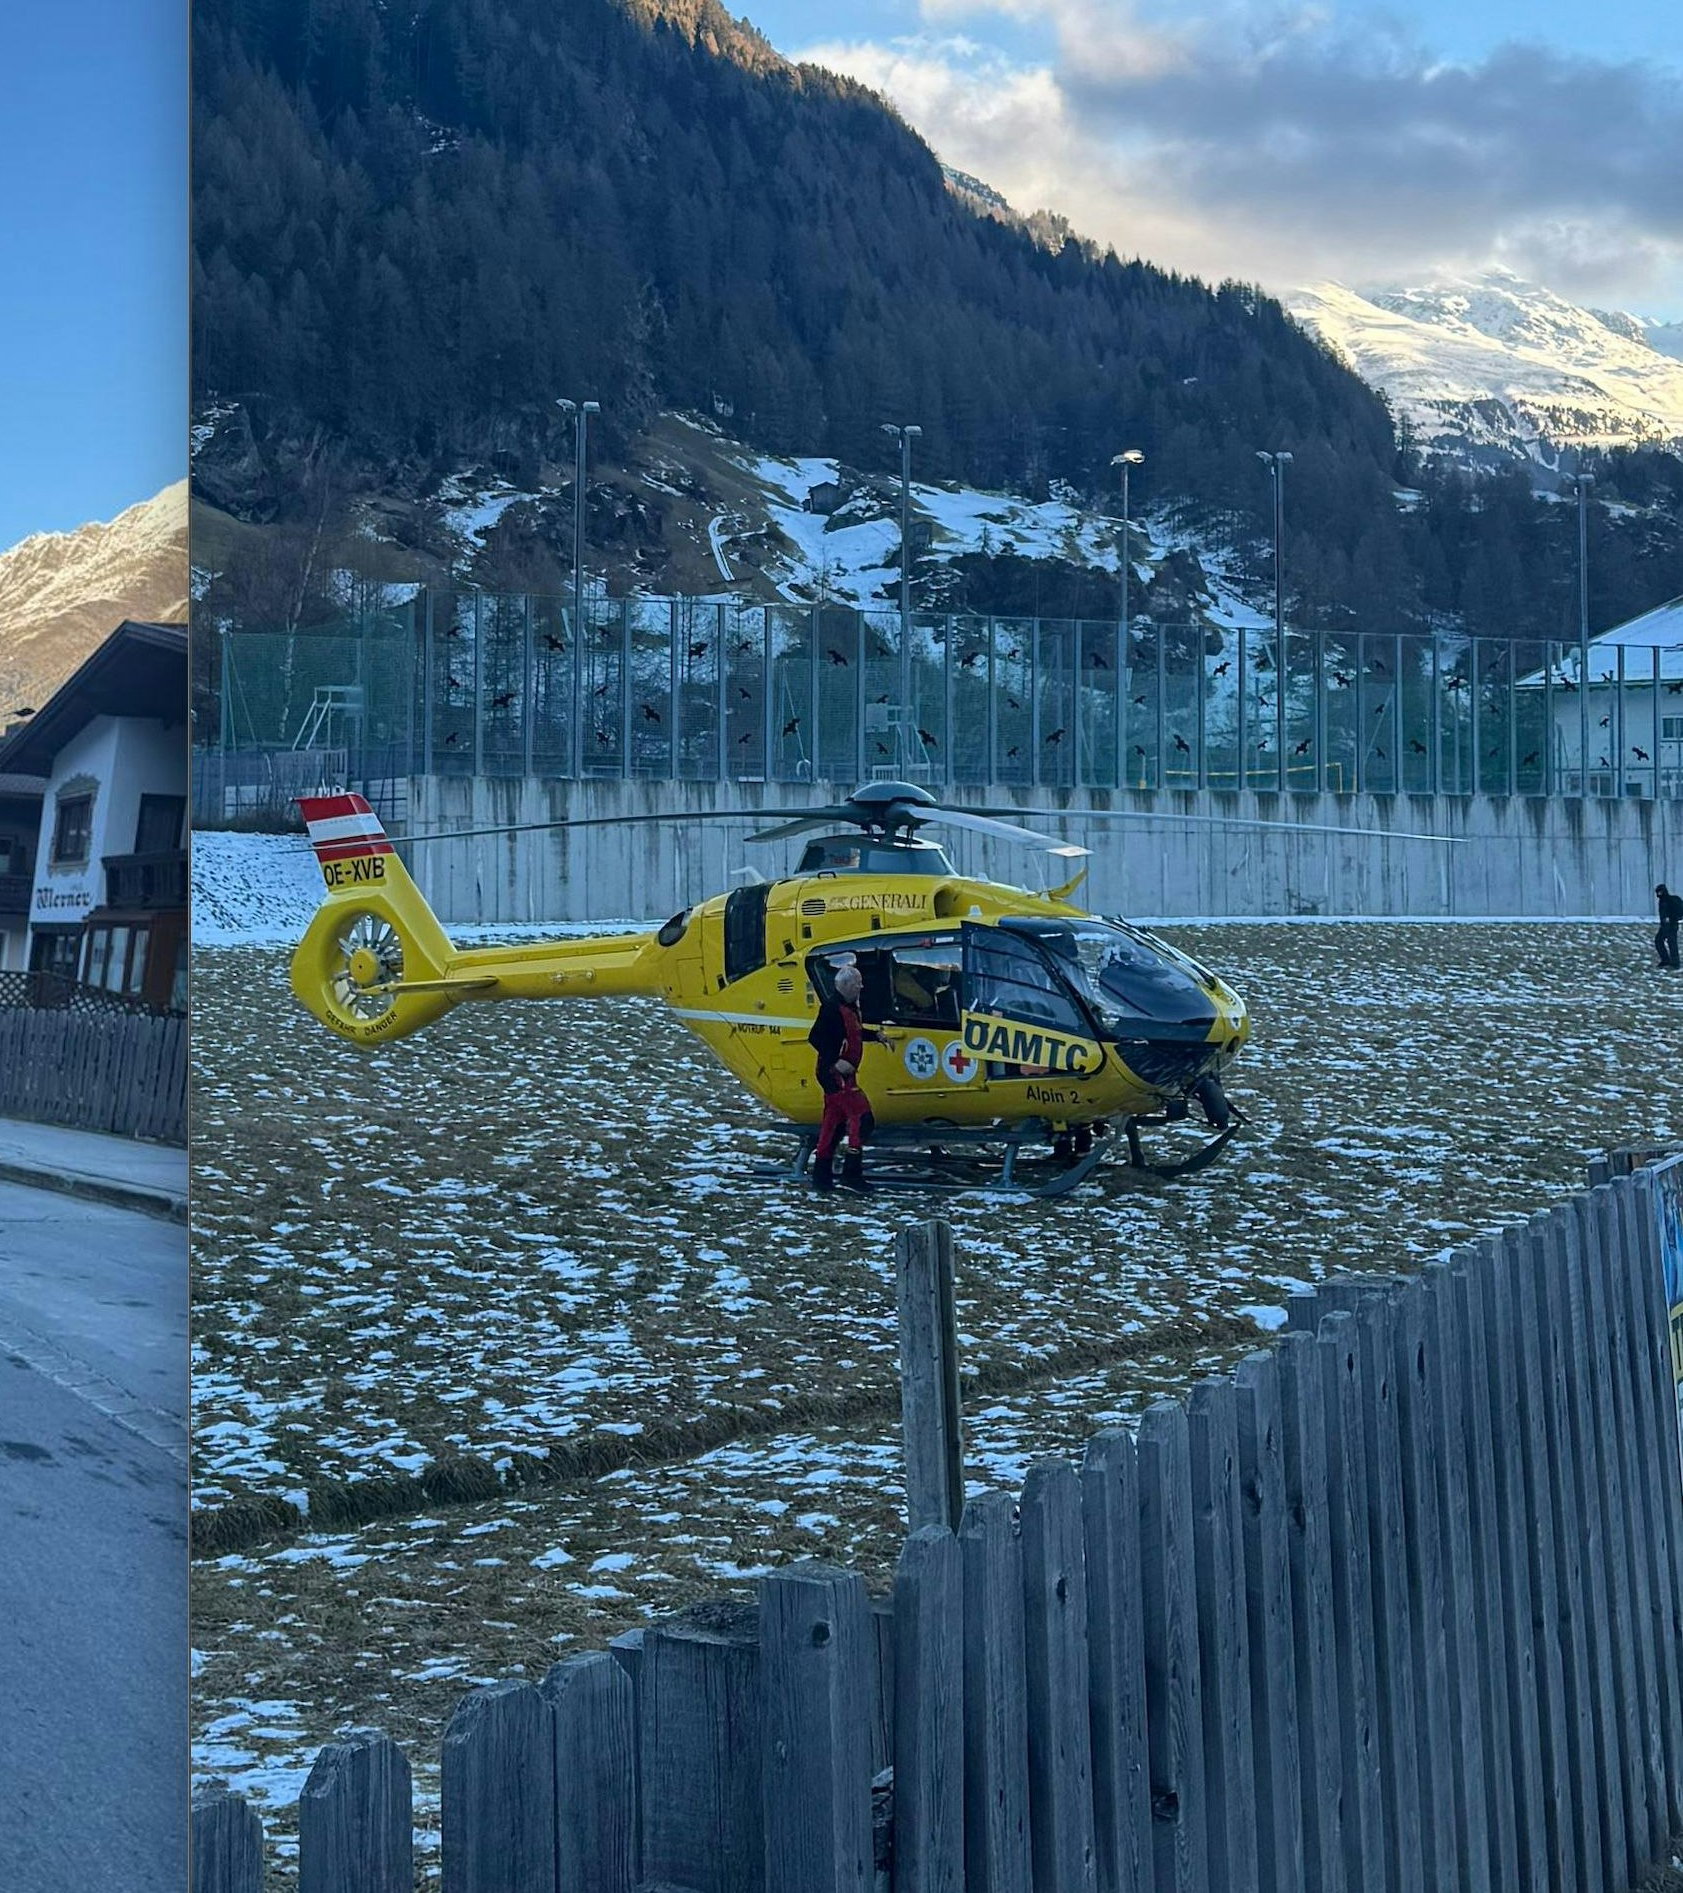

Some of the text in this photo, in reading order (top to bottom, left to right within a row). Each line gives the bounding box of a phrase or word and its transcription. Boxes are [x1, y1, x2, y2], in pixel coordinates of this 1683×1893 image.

[323, 857, 385, 886] OE-XVB
[36, 887, 90, 909] Werner
[849, 893, 929, 911] GENERALI
[325, 1010, 398, 1036] GEFAHR DANGER
[964, 1018, 1088, 1074] ÖAMTC
[1026, 1085, 1080, 1105] Alpin 2
